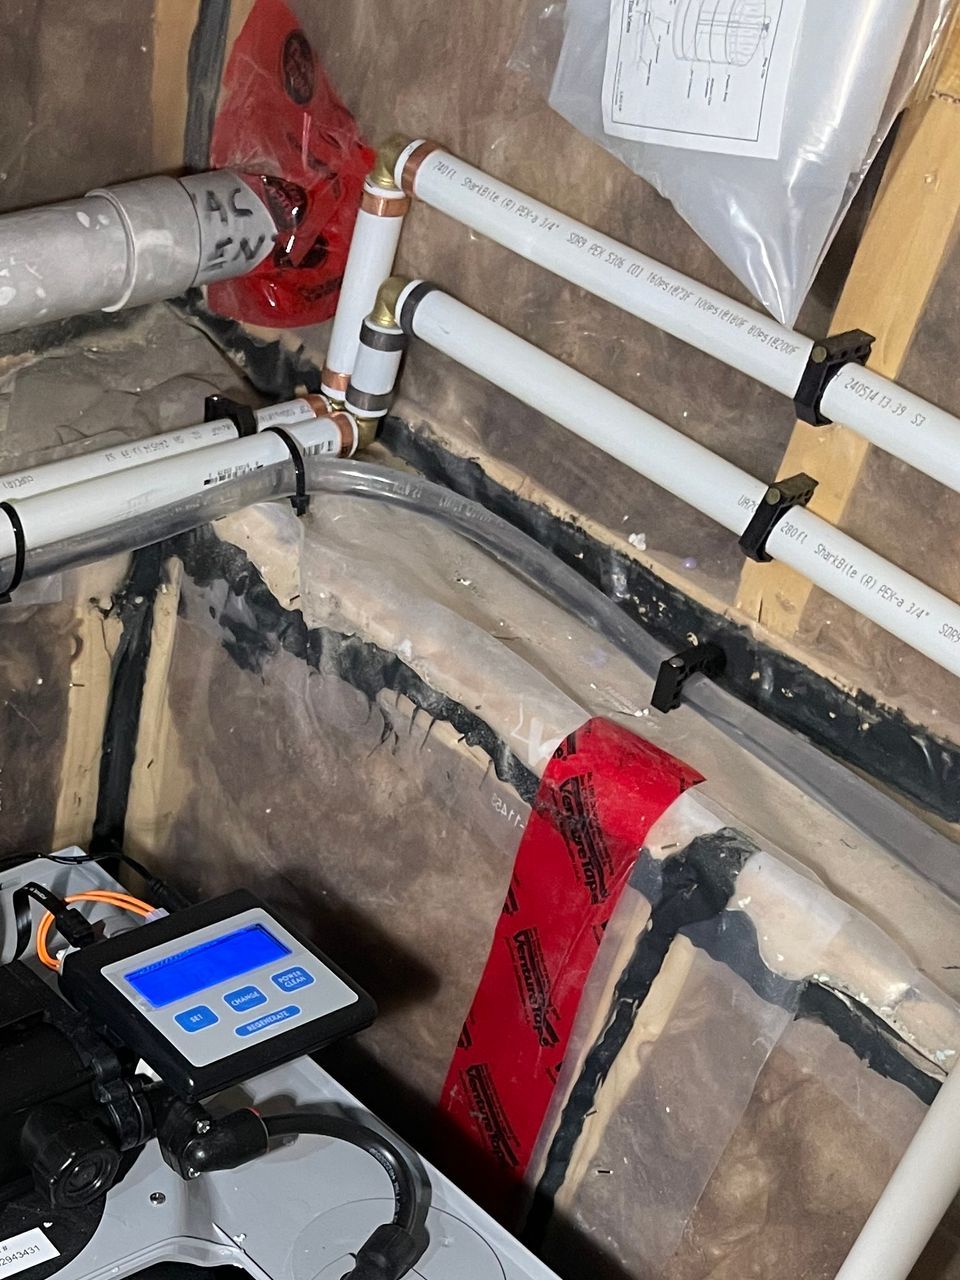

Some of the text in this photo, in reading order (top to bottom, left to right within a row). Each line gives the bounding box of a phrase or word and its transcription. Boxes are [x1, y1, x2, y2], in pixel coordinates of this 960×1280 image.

[588, 244, 607, 259] PEX
[814, 543, 857, 578] SharkBite
[860, 574, 877, 590] (R)
[877, 585, 904, 607] PEX-a
[278, 970, 303, 983] POWER
[284, 976, 306, 988] CLEAN
[230, 990, 260, 1006] CHANGE
[189, 1014, 204, 1023] SET
[246, 1010, 290, 1032] REGENERATE
